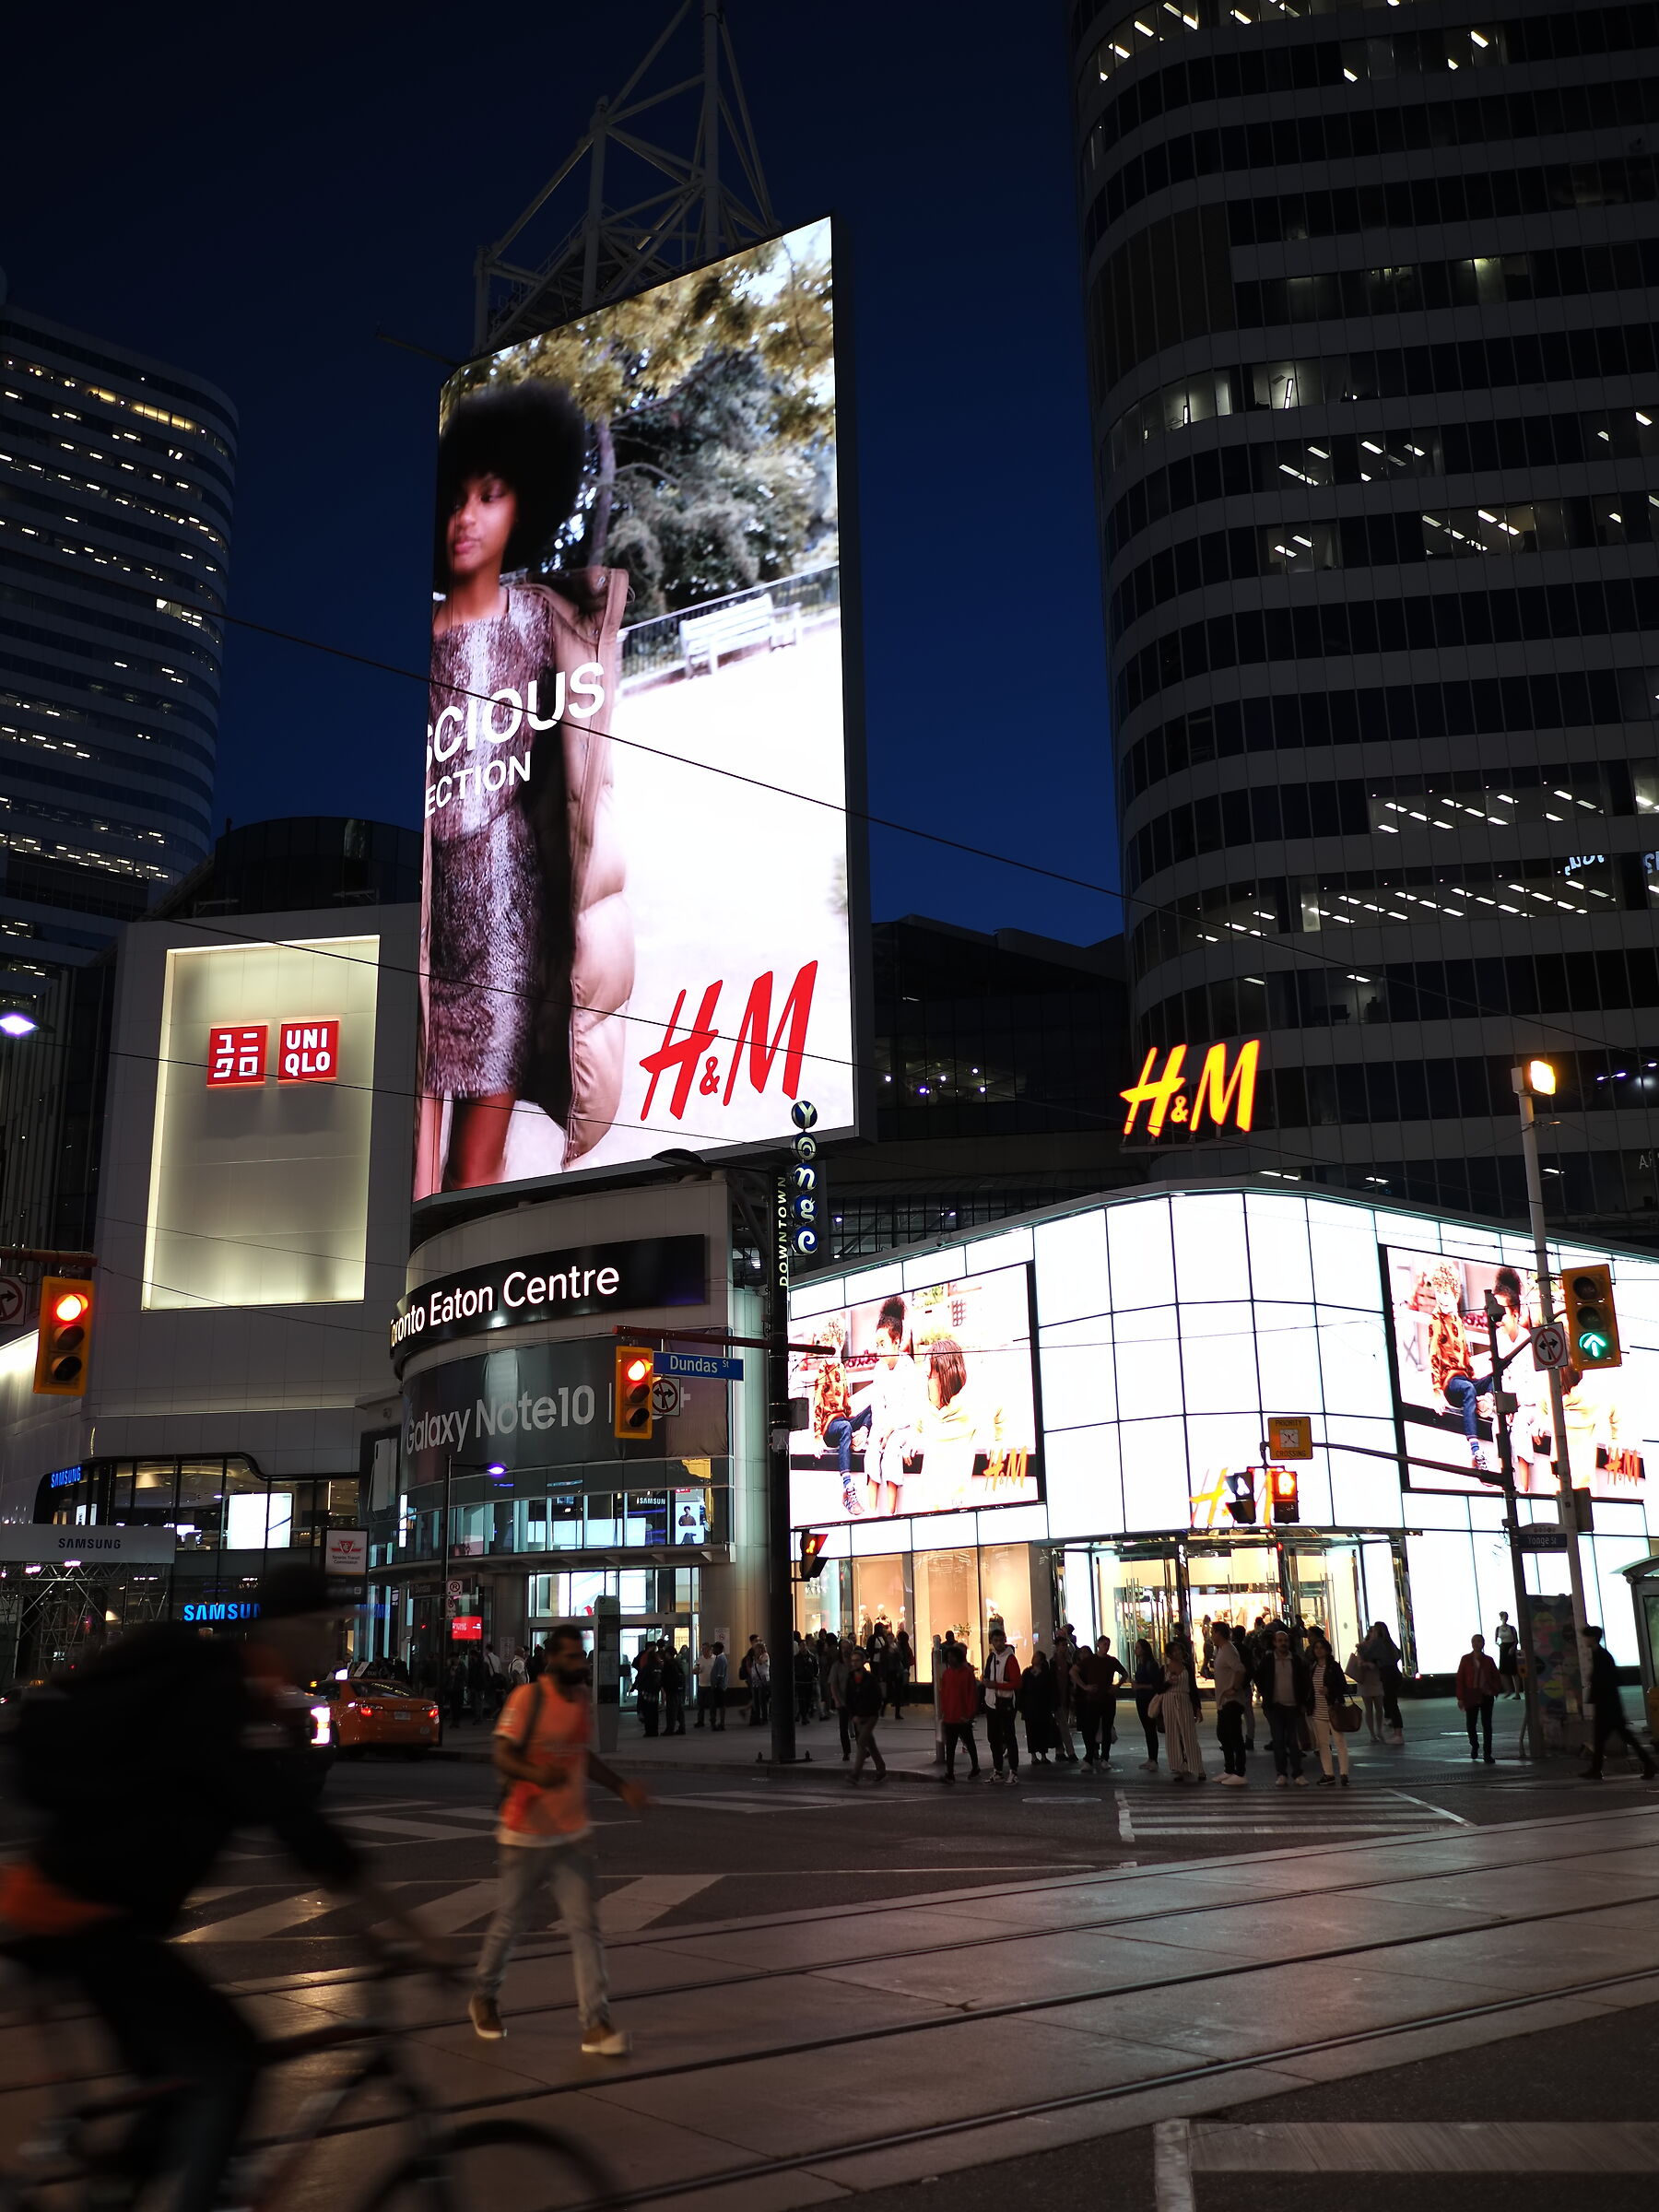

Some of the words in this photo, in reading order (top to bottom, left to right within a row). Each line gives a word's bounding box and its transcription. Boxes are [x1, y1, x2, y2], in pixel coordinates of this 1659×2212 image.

[424, 751, 532, 819] ECTION
[286, 1028, 328, 1051] UNI
[638, 959, 818, 1122] H&M
[284, 1051, 331, 1077] QLO
[1119, 1039, 1261, 1138] H&M
[777, 1177, 788, 1287] DOWNTOWN
[390, 1304, 426, 1347] oronto
[429, 1286, 494, 1326] Eaton
[501, 1265, 620, 1309] Centre
[669, 1355, 718, 1374] Dundas
[722, 1359, 730, 1369] St
[406, 1408, 471, 1455] Galaxy
[476, 1384, 595, 1438] Note10
[51, 1465, 82, 1488] SAMSUNG
[982, 1445, 1028, 1491] H&M
[58, 1537, 122, 1549] SAMSUNG
[1527, 1535, 1549, 1547] Yonge
[1550, 1536, 1557, 1545] St
